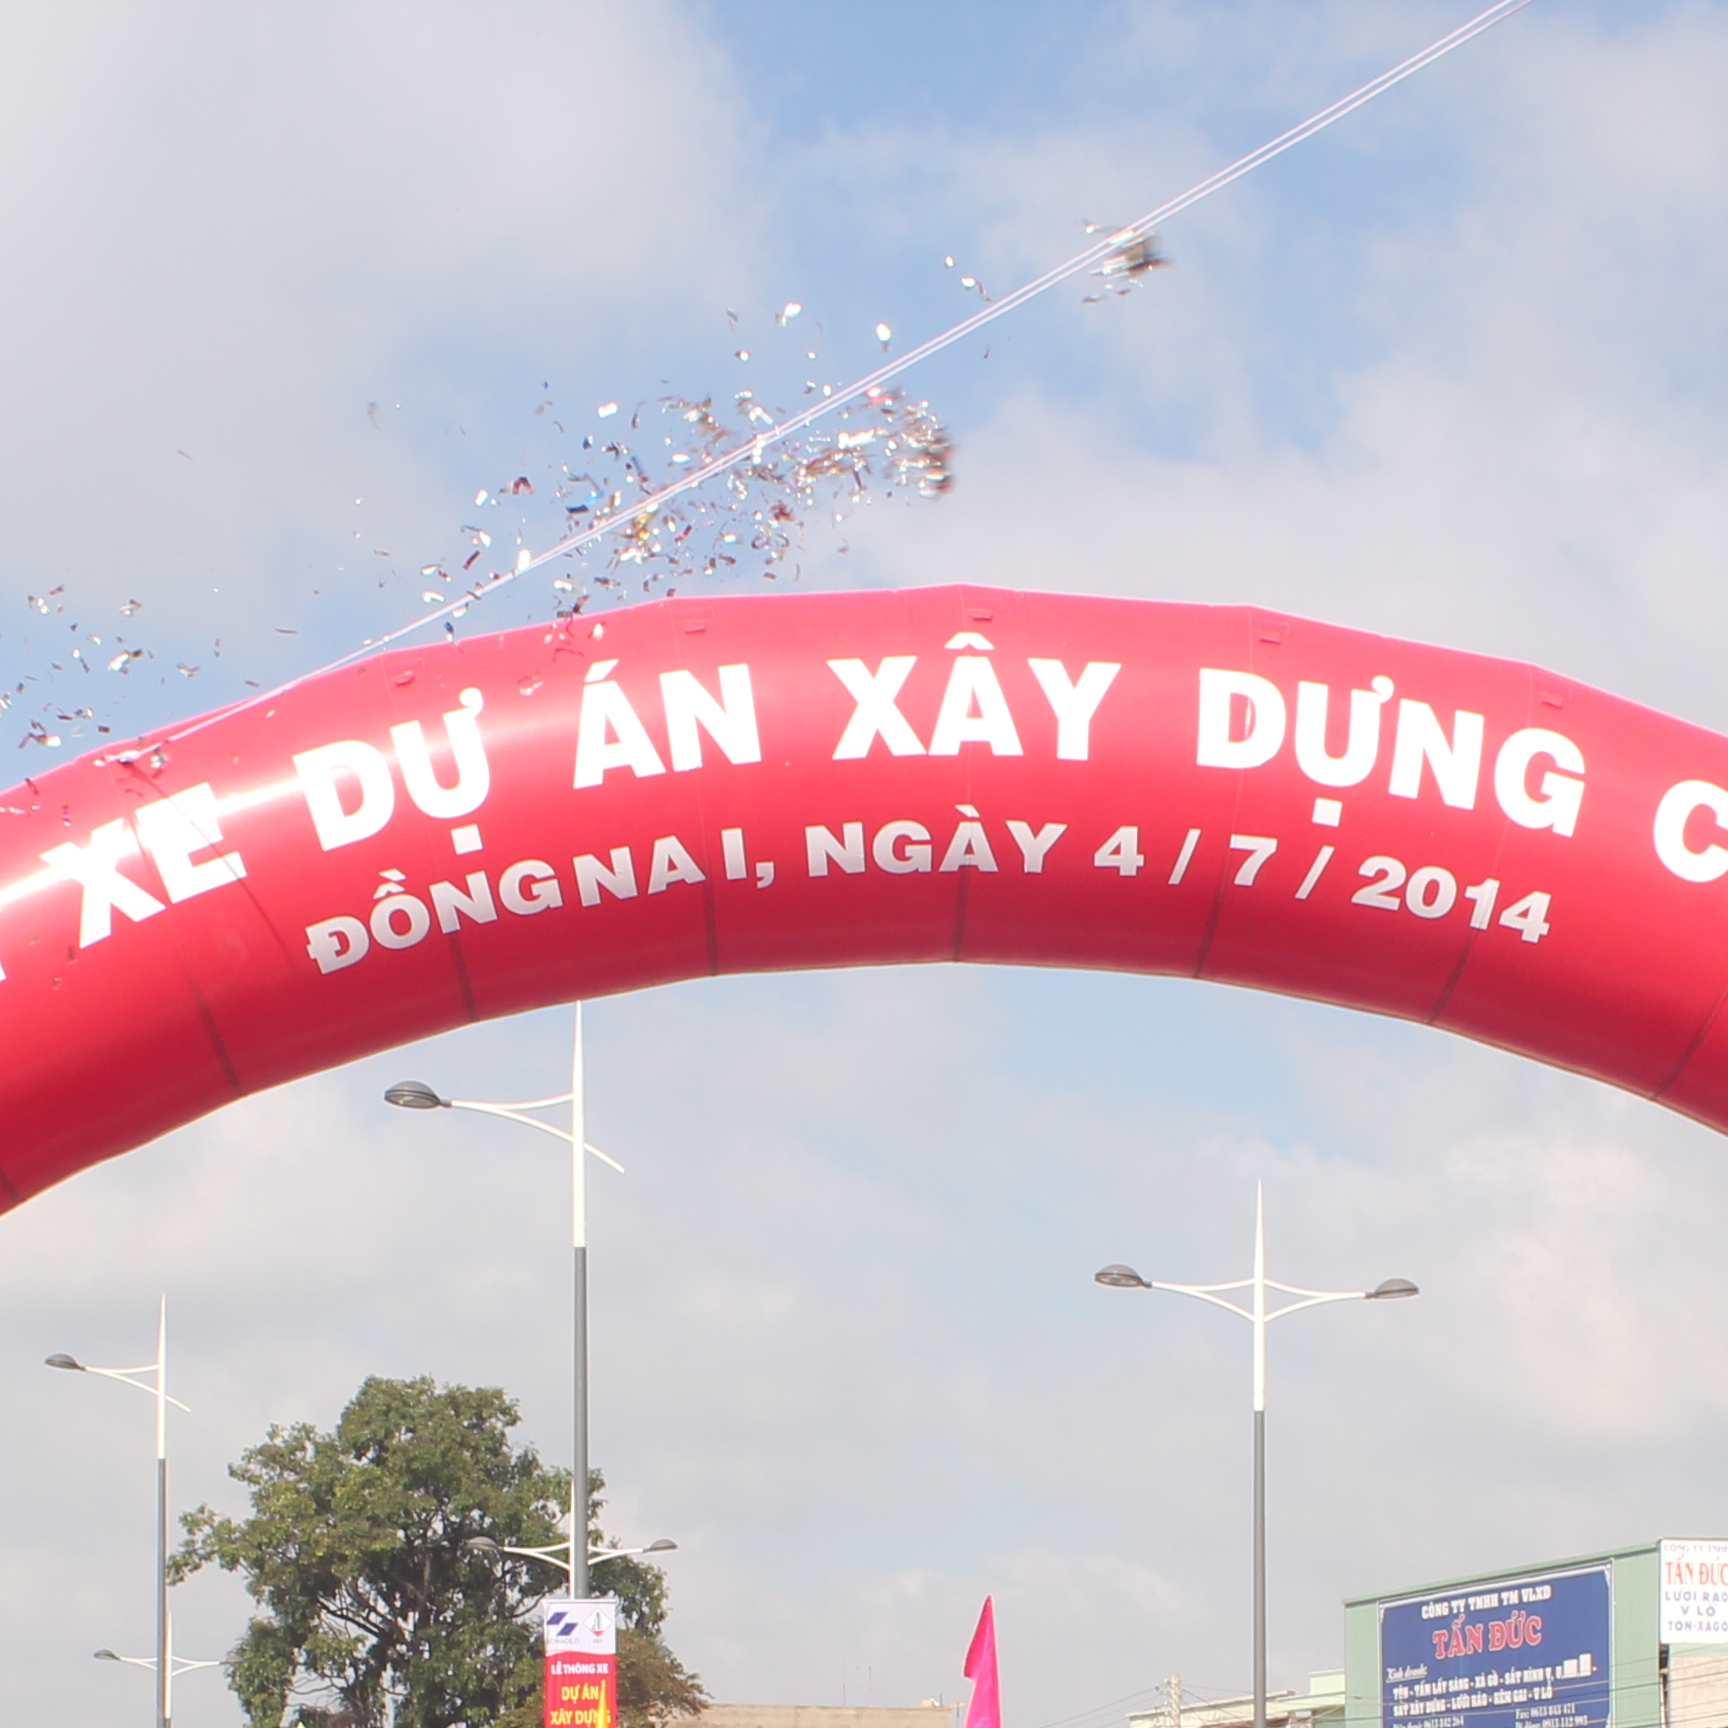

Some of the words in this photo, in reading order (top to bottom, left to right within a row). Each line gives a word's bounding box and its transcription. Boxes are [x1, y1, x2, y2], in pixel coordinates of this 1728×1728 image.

[39, 781, 248, 949] XE
[292, 687, 490, 855] DỰ
[573, 659, 762, 789] ÁN
[827, 632, 1121, 760] XÂY
[1196, 675, 1585, 837] DỰNG
[805, 805, 1067, 877] NGÀY
[1351, 856, 1552, 943] 2014
[1693, 1544, 1703, 1552] TY
[1665, 1553, 1694, 1585] TẤN
[1422, 1601, 1449, 1619] CÔNG
[1451, 1599, 1467, 1614] TY
[1469, 1593, 1499, 1611] TNHH
[1501, 1589, 1519, 1606] TM
[1522, 1584, 1552, 1603] VLXD
[1433, 1614, 1484, 1659] TẤN
[1489, 1610, 1542, 1651] ĐỨC
[551, 1660, 563, 1675] LỄ
[563, 1661, 595, 1674] THÔNG
[597, 1663, 609, 1674] XE
[561, 1684, 580, 1704] DỰ
[582, 1684, 599, 1701] ÁN
[550, 1709, 574, 1725] XÂY
